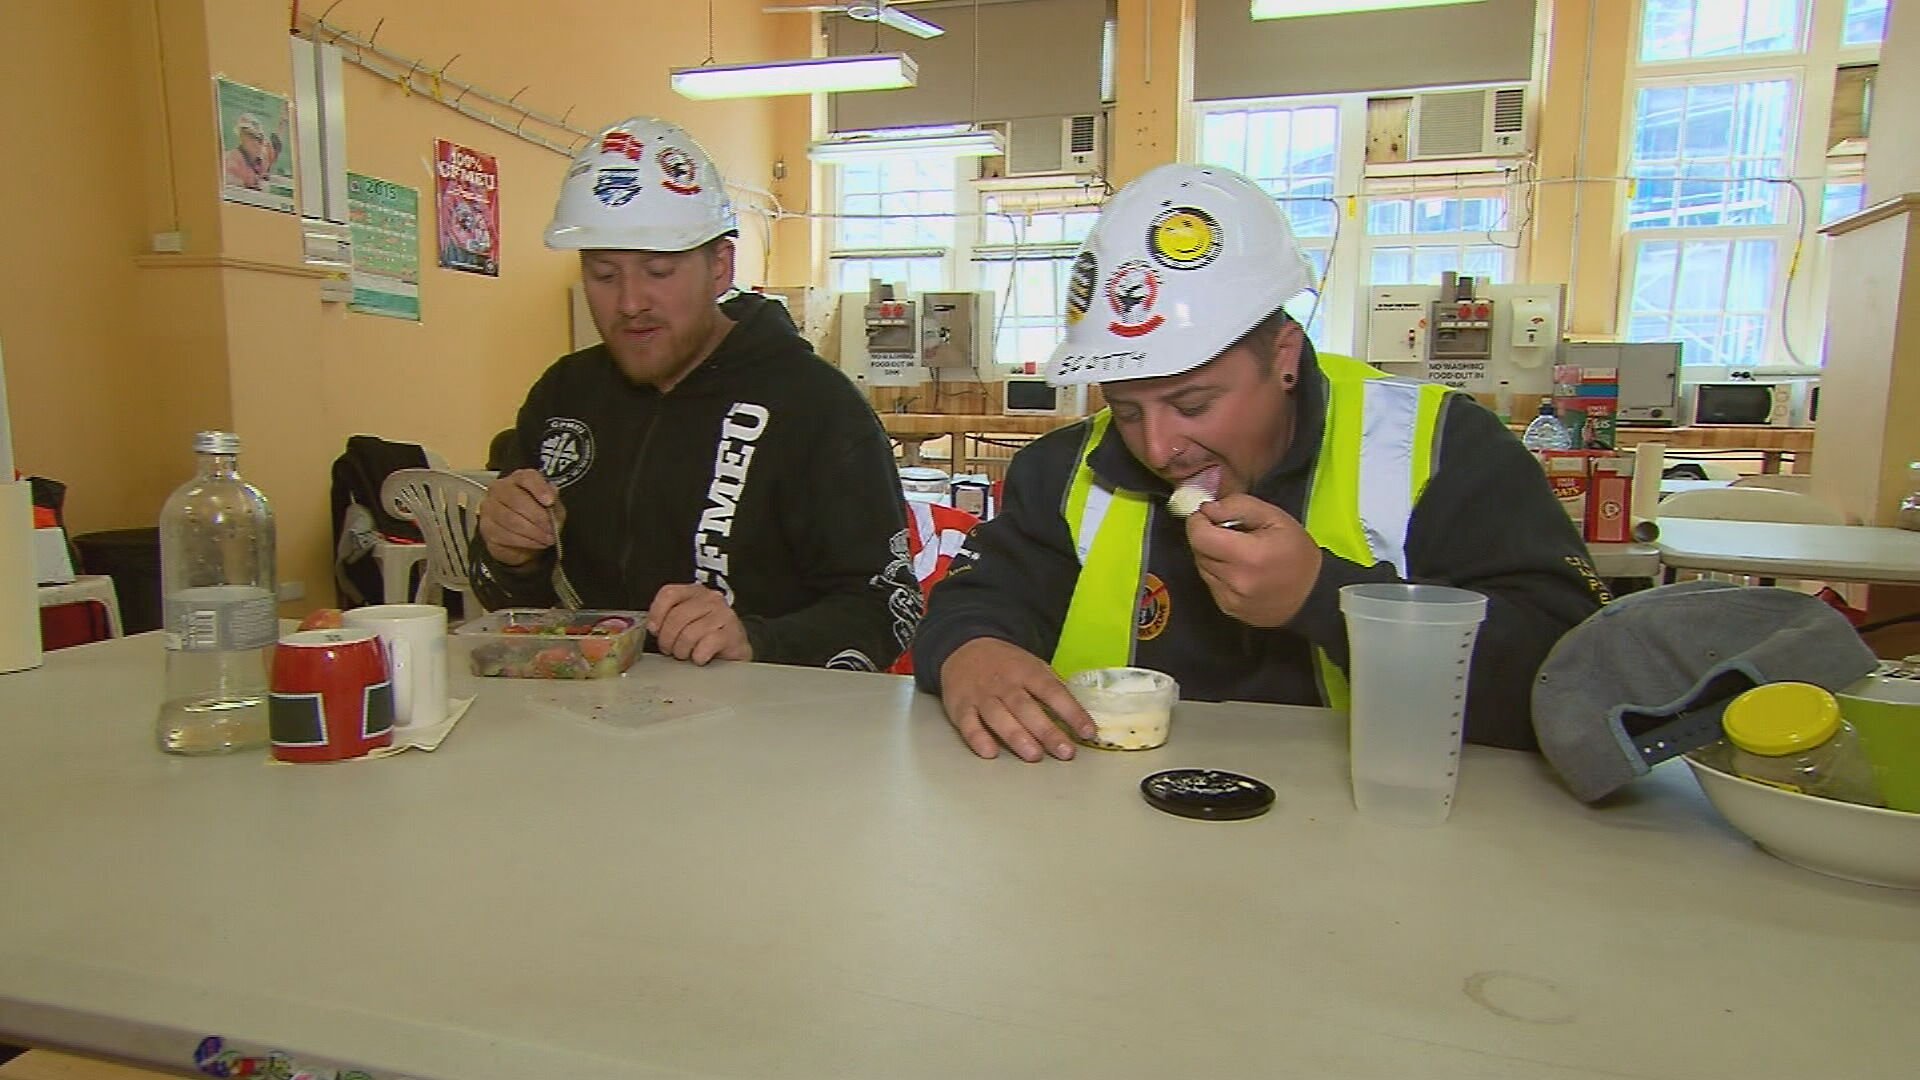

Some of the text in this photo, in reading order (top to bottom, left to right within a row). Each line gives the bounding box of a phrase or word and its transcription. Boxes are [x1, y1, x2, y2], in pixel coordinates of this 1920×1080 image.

[438, 160, 495, 190] CFMEU
[366, 180, 397, 199] 2015
[1057, 351, 1147, 376] SCOTTY
